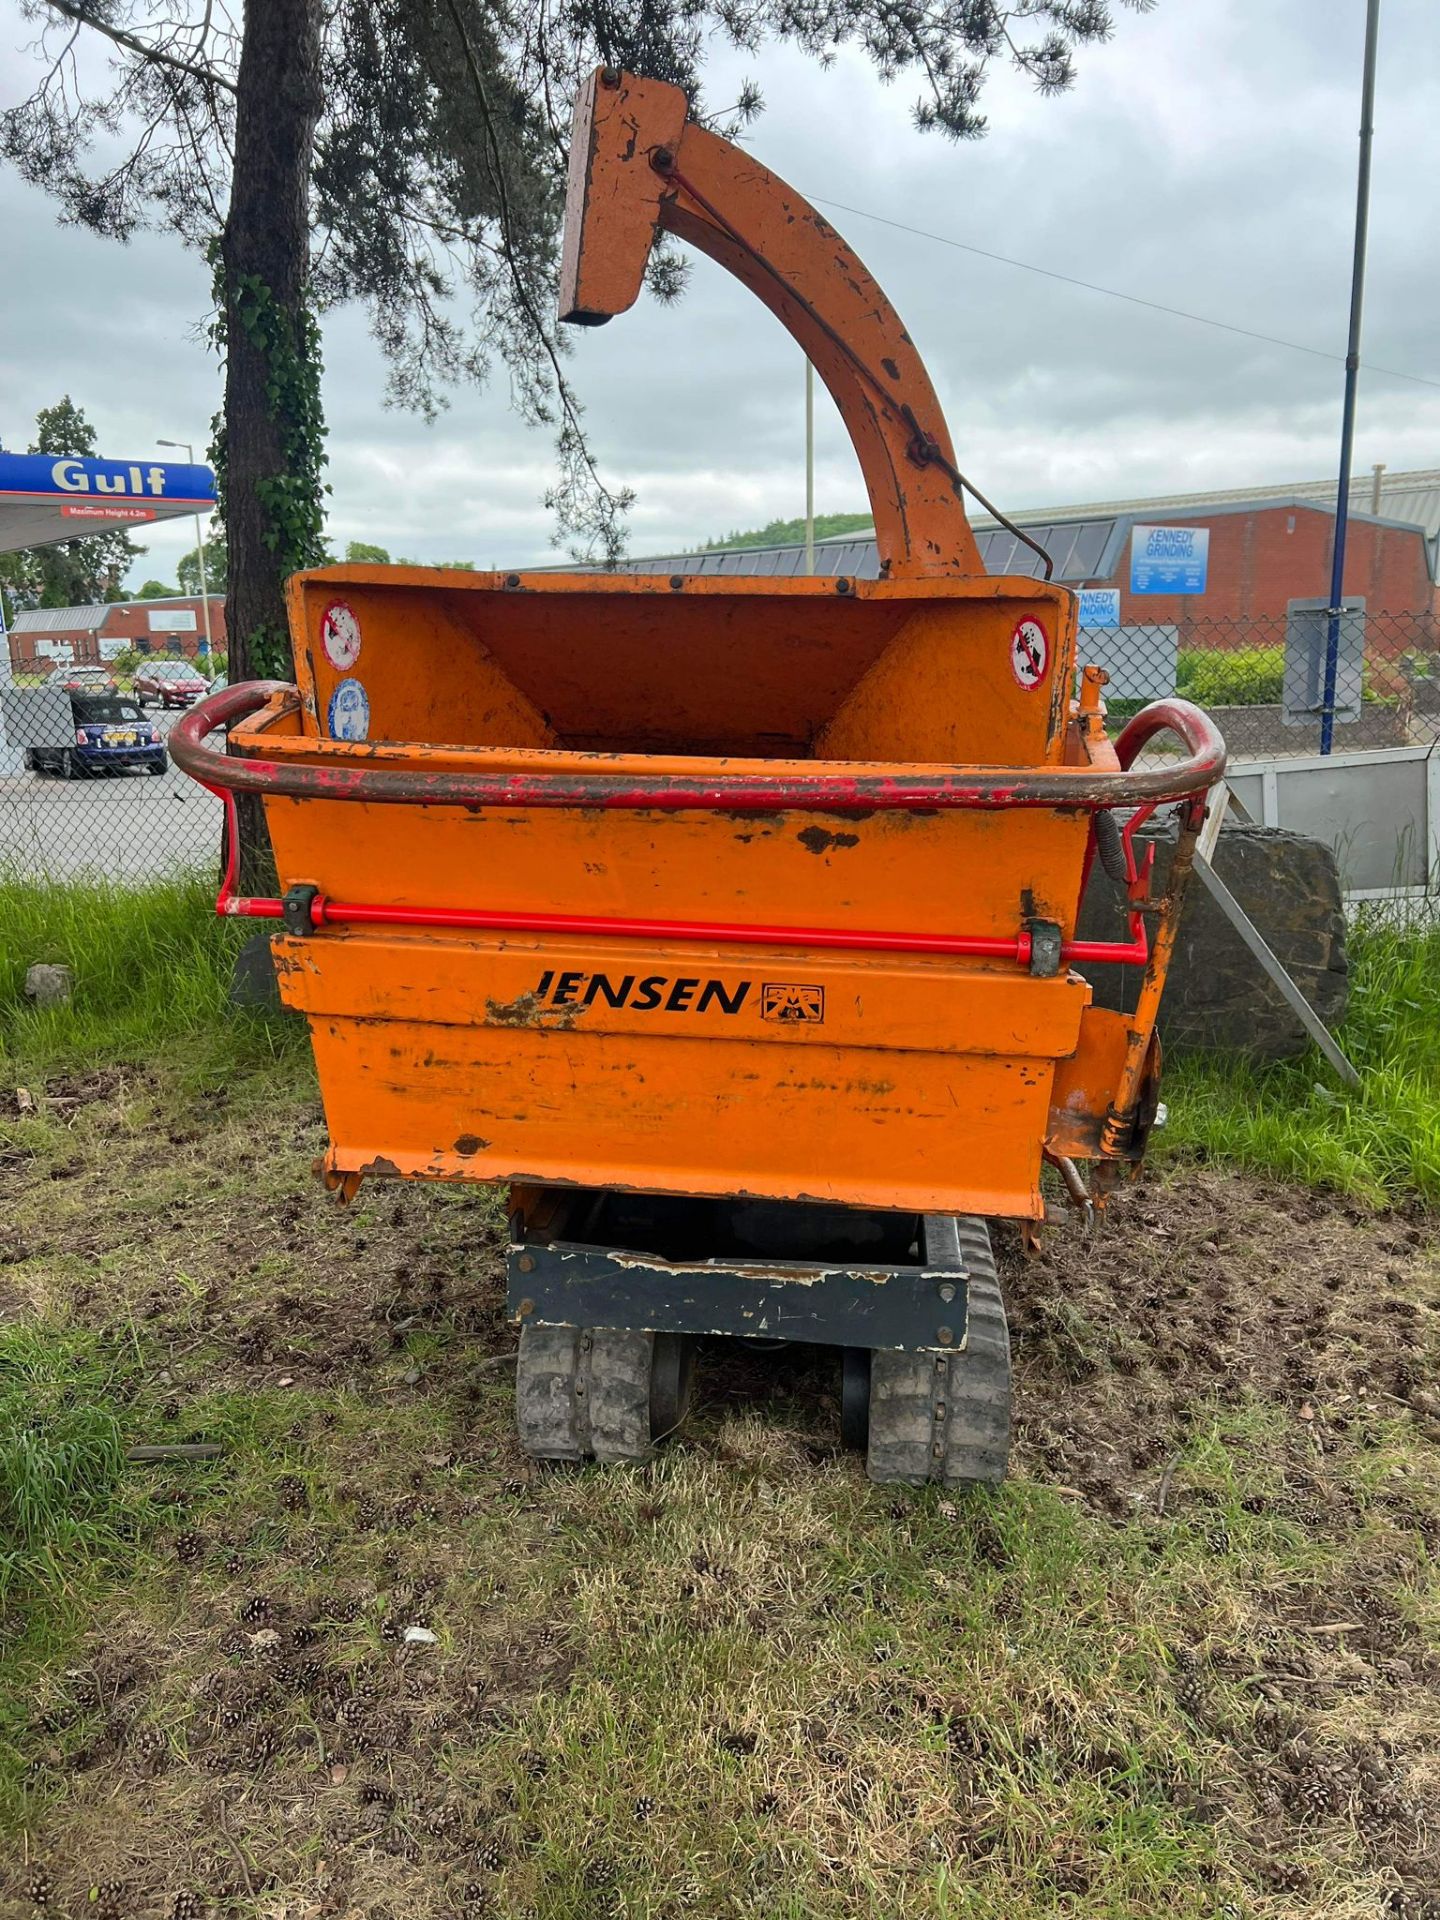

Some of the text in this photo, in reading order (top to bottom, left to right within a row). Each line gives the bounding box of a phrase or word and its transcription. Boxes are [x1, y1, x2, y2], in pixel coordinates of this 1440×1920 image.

[52, 460, 165, 495] Gulf
[69, 507, 104, 516] Maximum
[105, 509, 128, 518] Height
[1148, 529, 1195, 543] KENNEDY
[1146, 543, 1193, 557] GRINDING
[1076, 592, 1115, 603] NNEDY
[1080, 604, 1114, 615] INDING
[535, 970, 751, 1015] JENSEN
